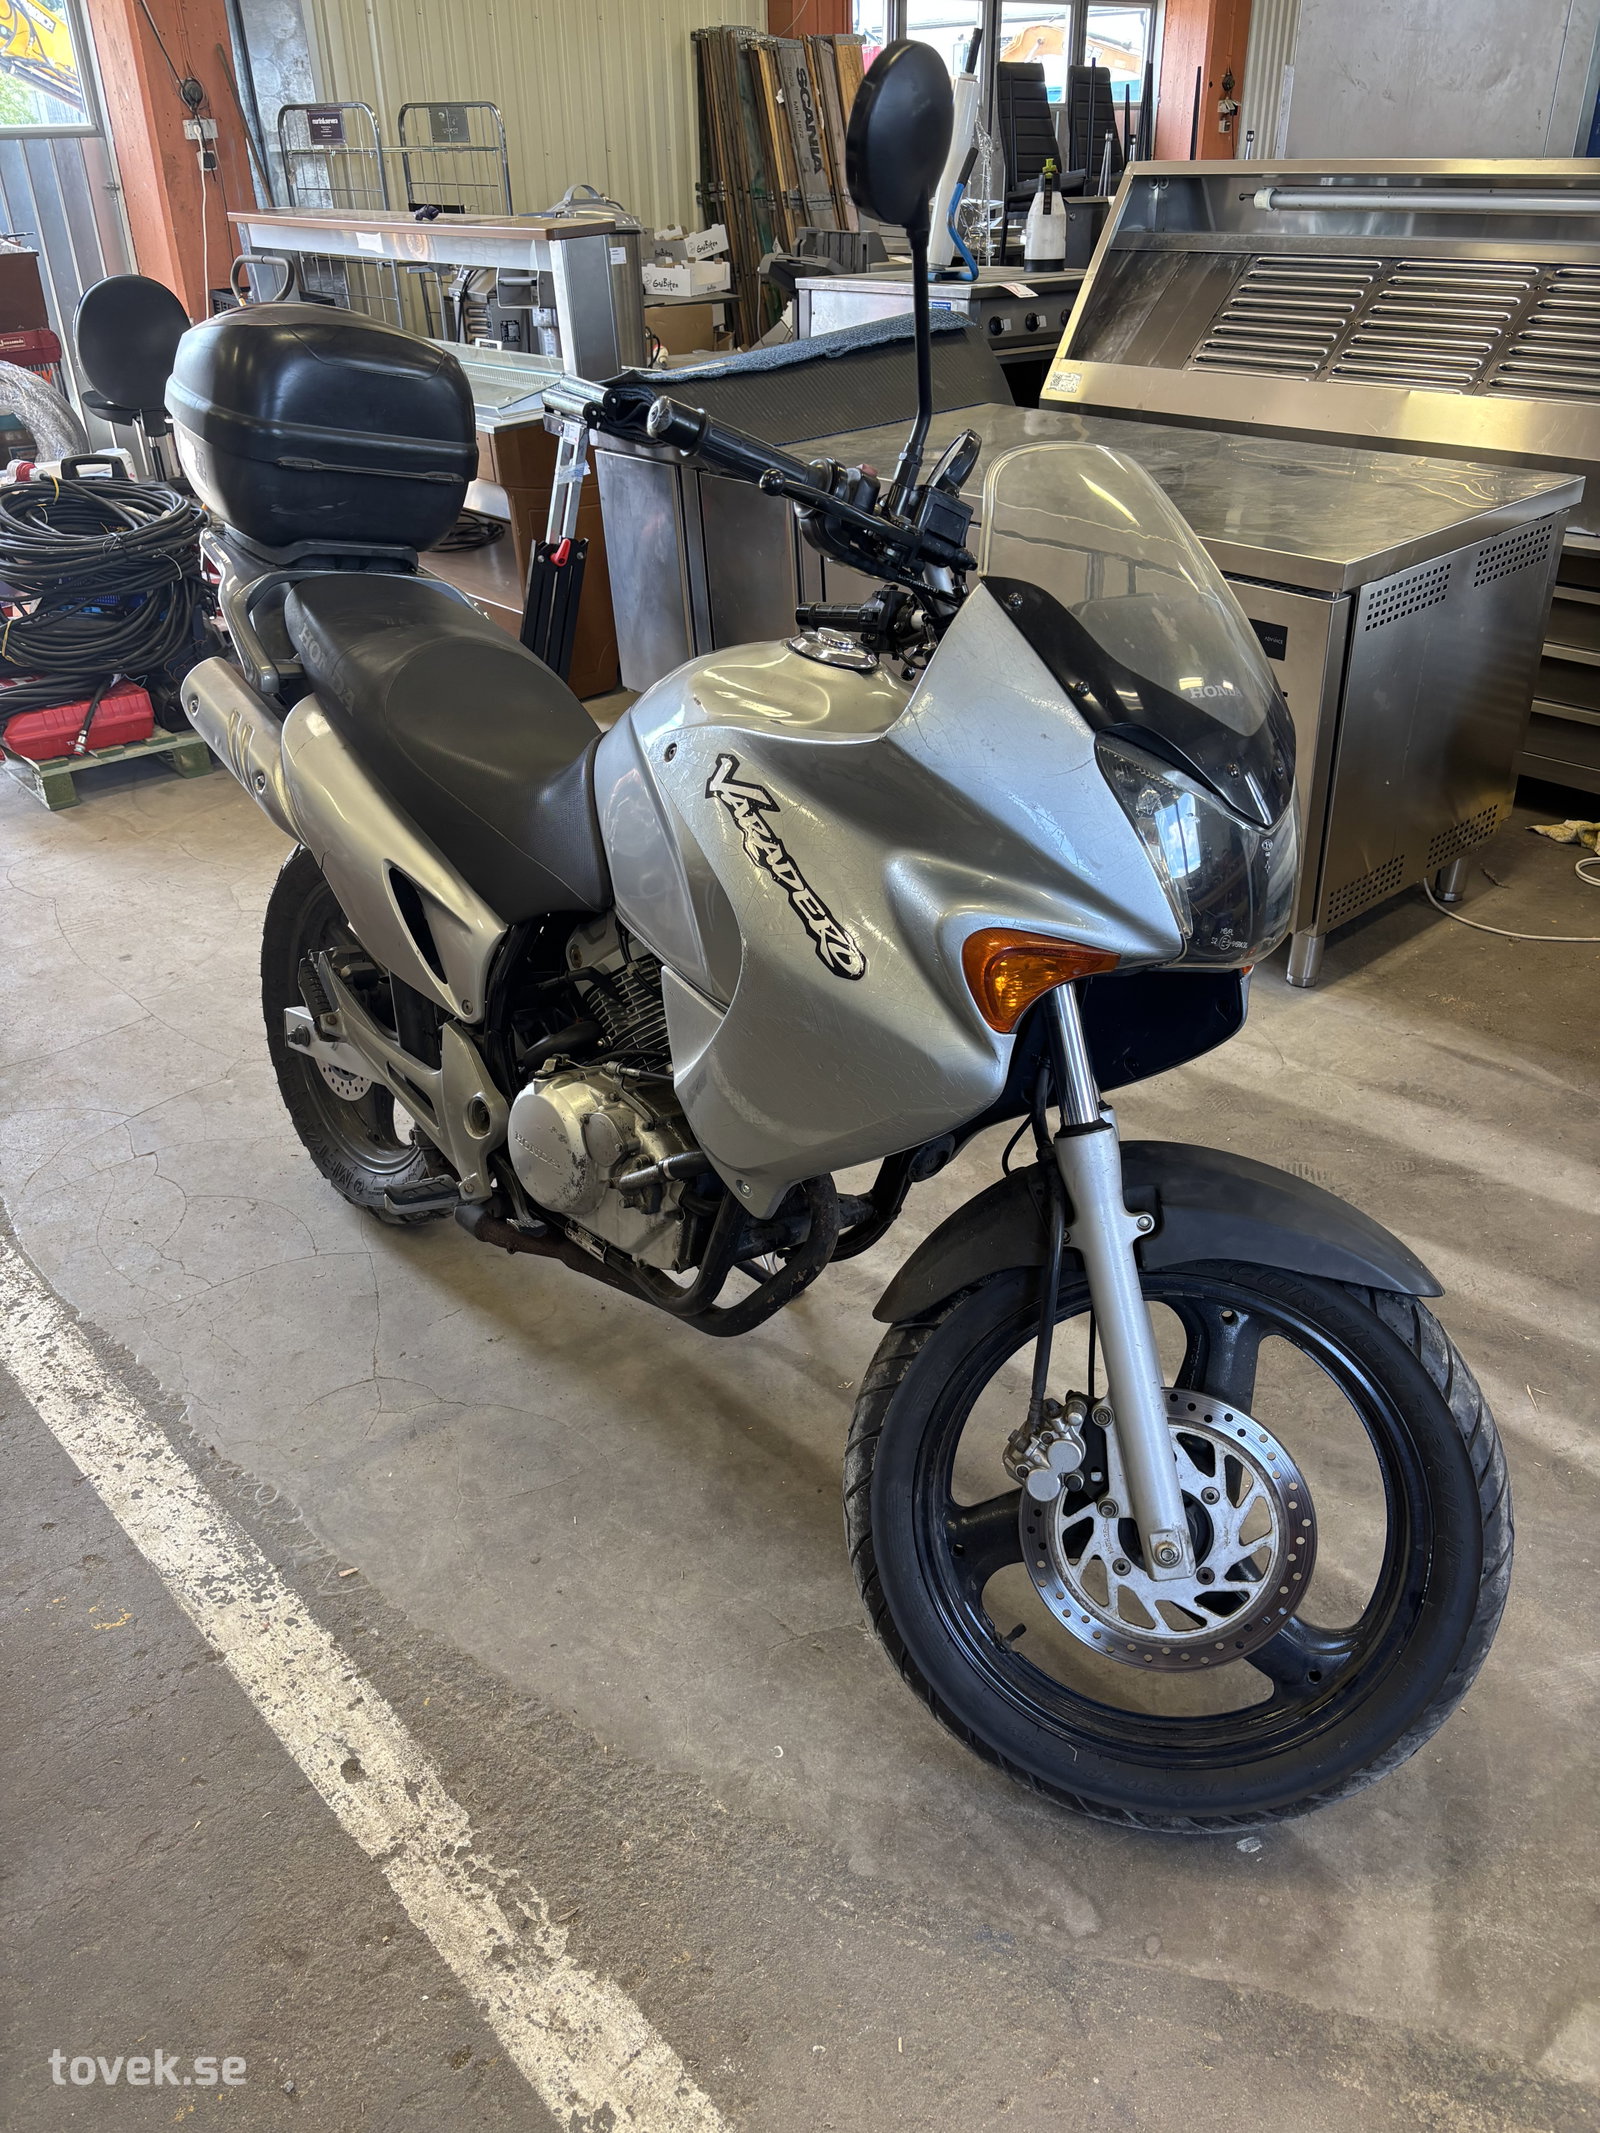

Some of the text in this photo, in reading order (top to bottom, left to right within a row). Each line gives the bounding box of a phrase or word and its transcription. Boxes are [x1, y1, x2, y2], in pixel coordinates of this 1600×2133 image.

[796, 66, 823, 175] SCANIA
[298, 622, 355, 717] HONDA
[1190, 684, 1243, 699] HONDA
[706, 754, 866, 980] VARADERO
